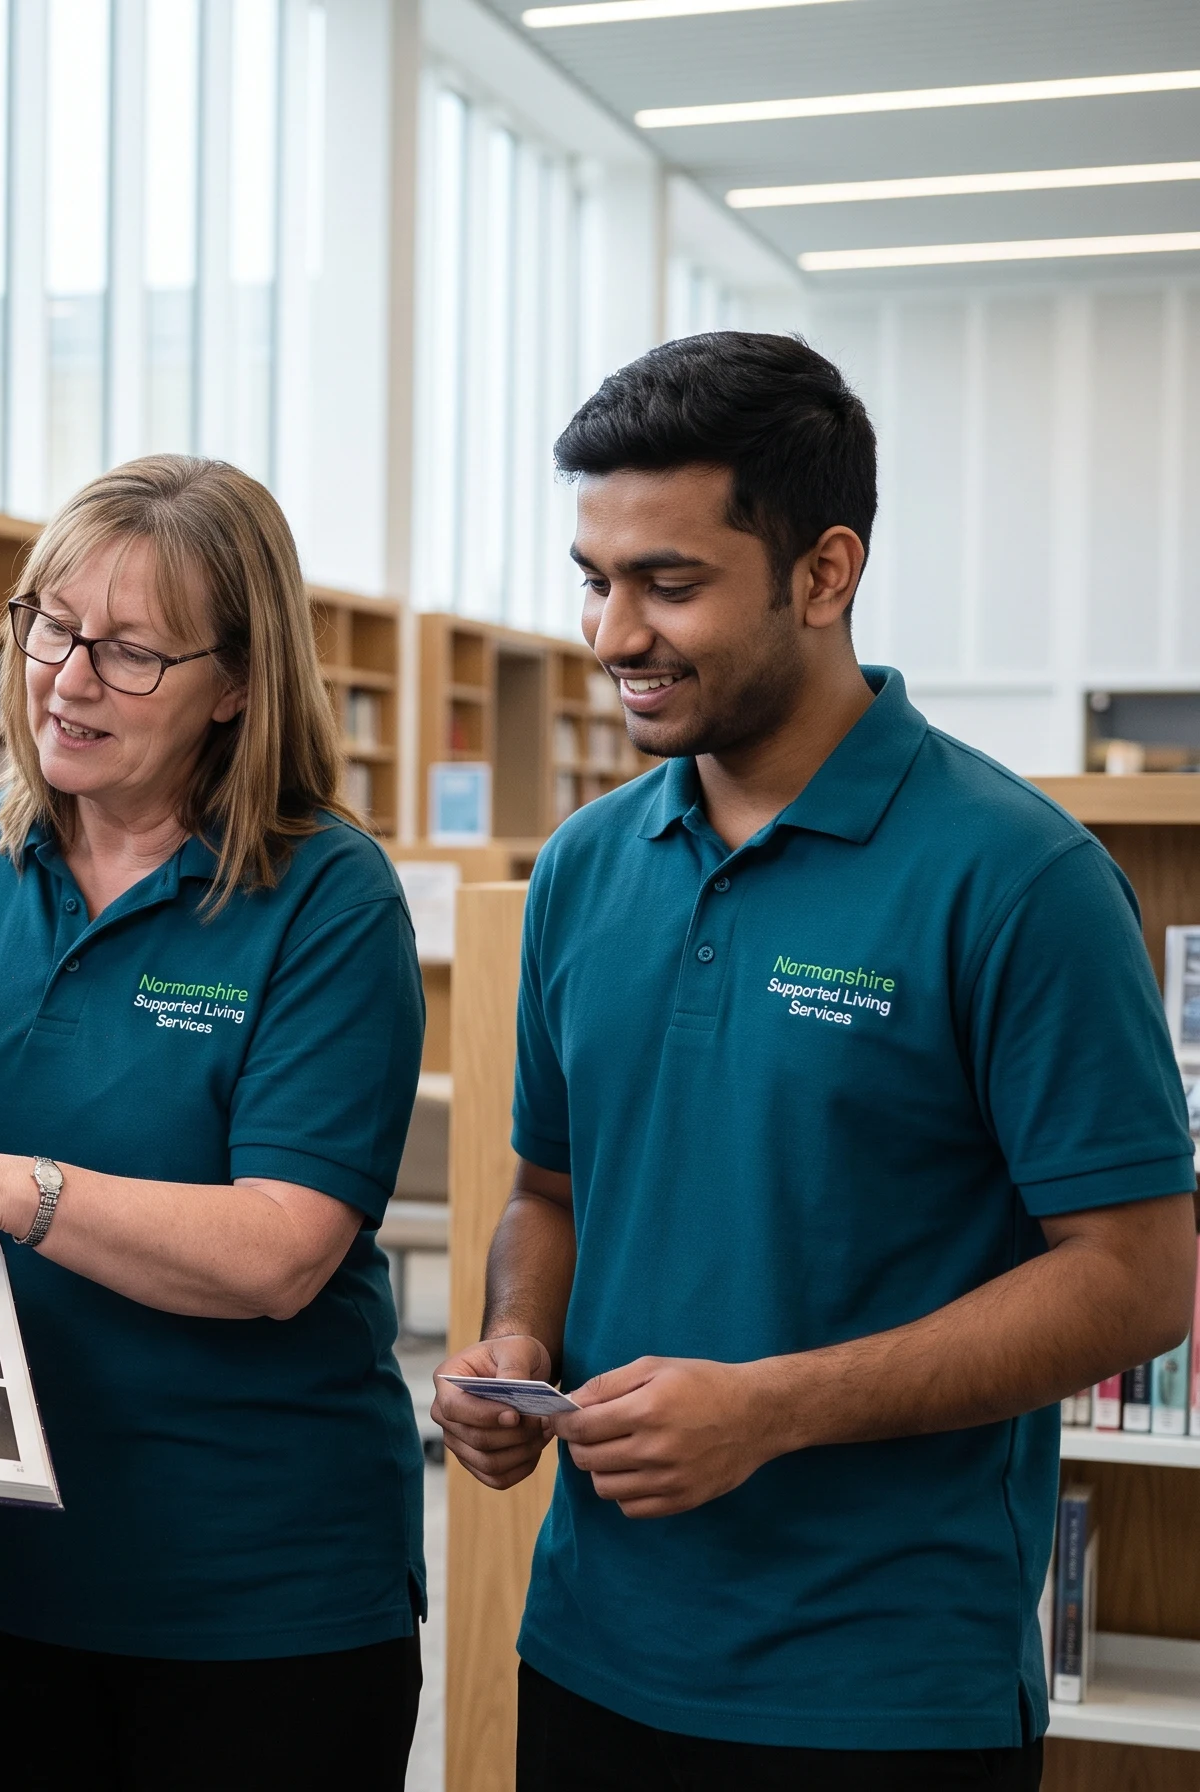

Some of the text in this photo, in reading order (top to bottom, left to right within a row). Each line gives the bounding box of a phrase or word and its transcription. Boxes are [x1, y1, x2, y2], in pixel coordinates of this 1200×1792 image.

[139, 973, 249, 1002] Normanshire
[772, 955, 895, 993] Normanshire
[133, 993, 245, 1024] Supported Living
[767, 977, 892, 1017] Supported Living
[788, 999, 853, 1025] Services
[155, 1014, 213, 1034] Services
